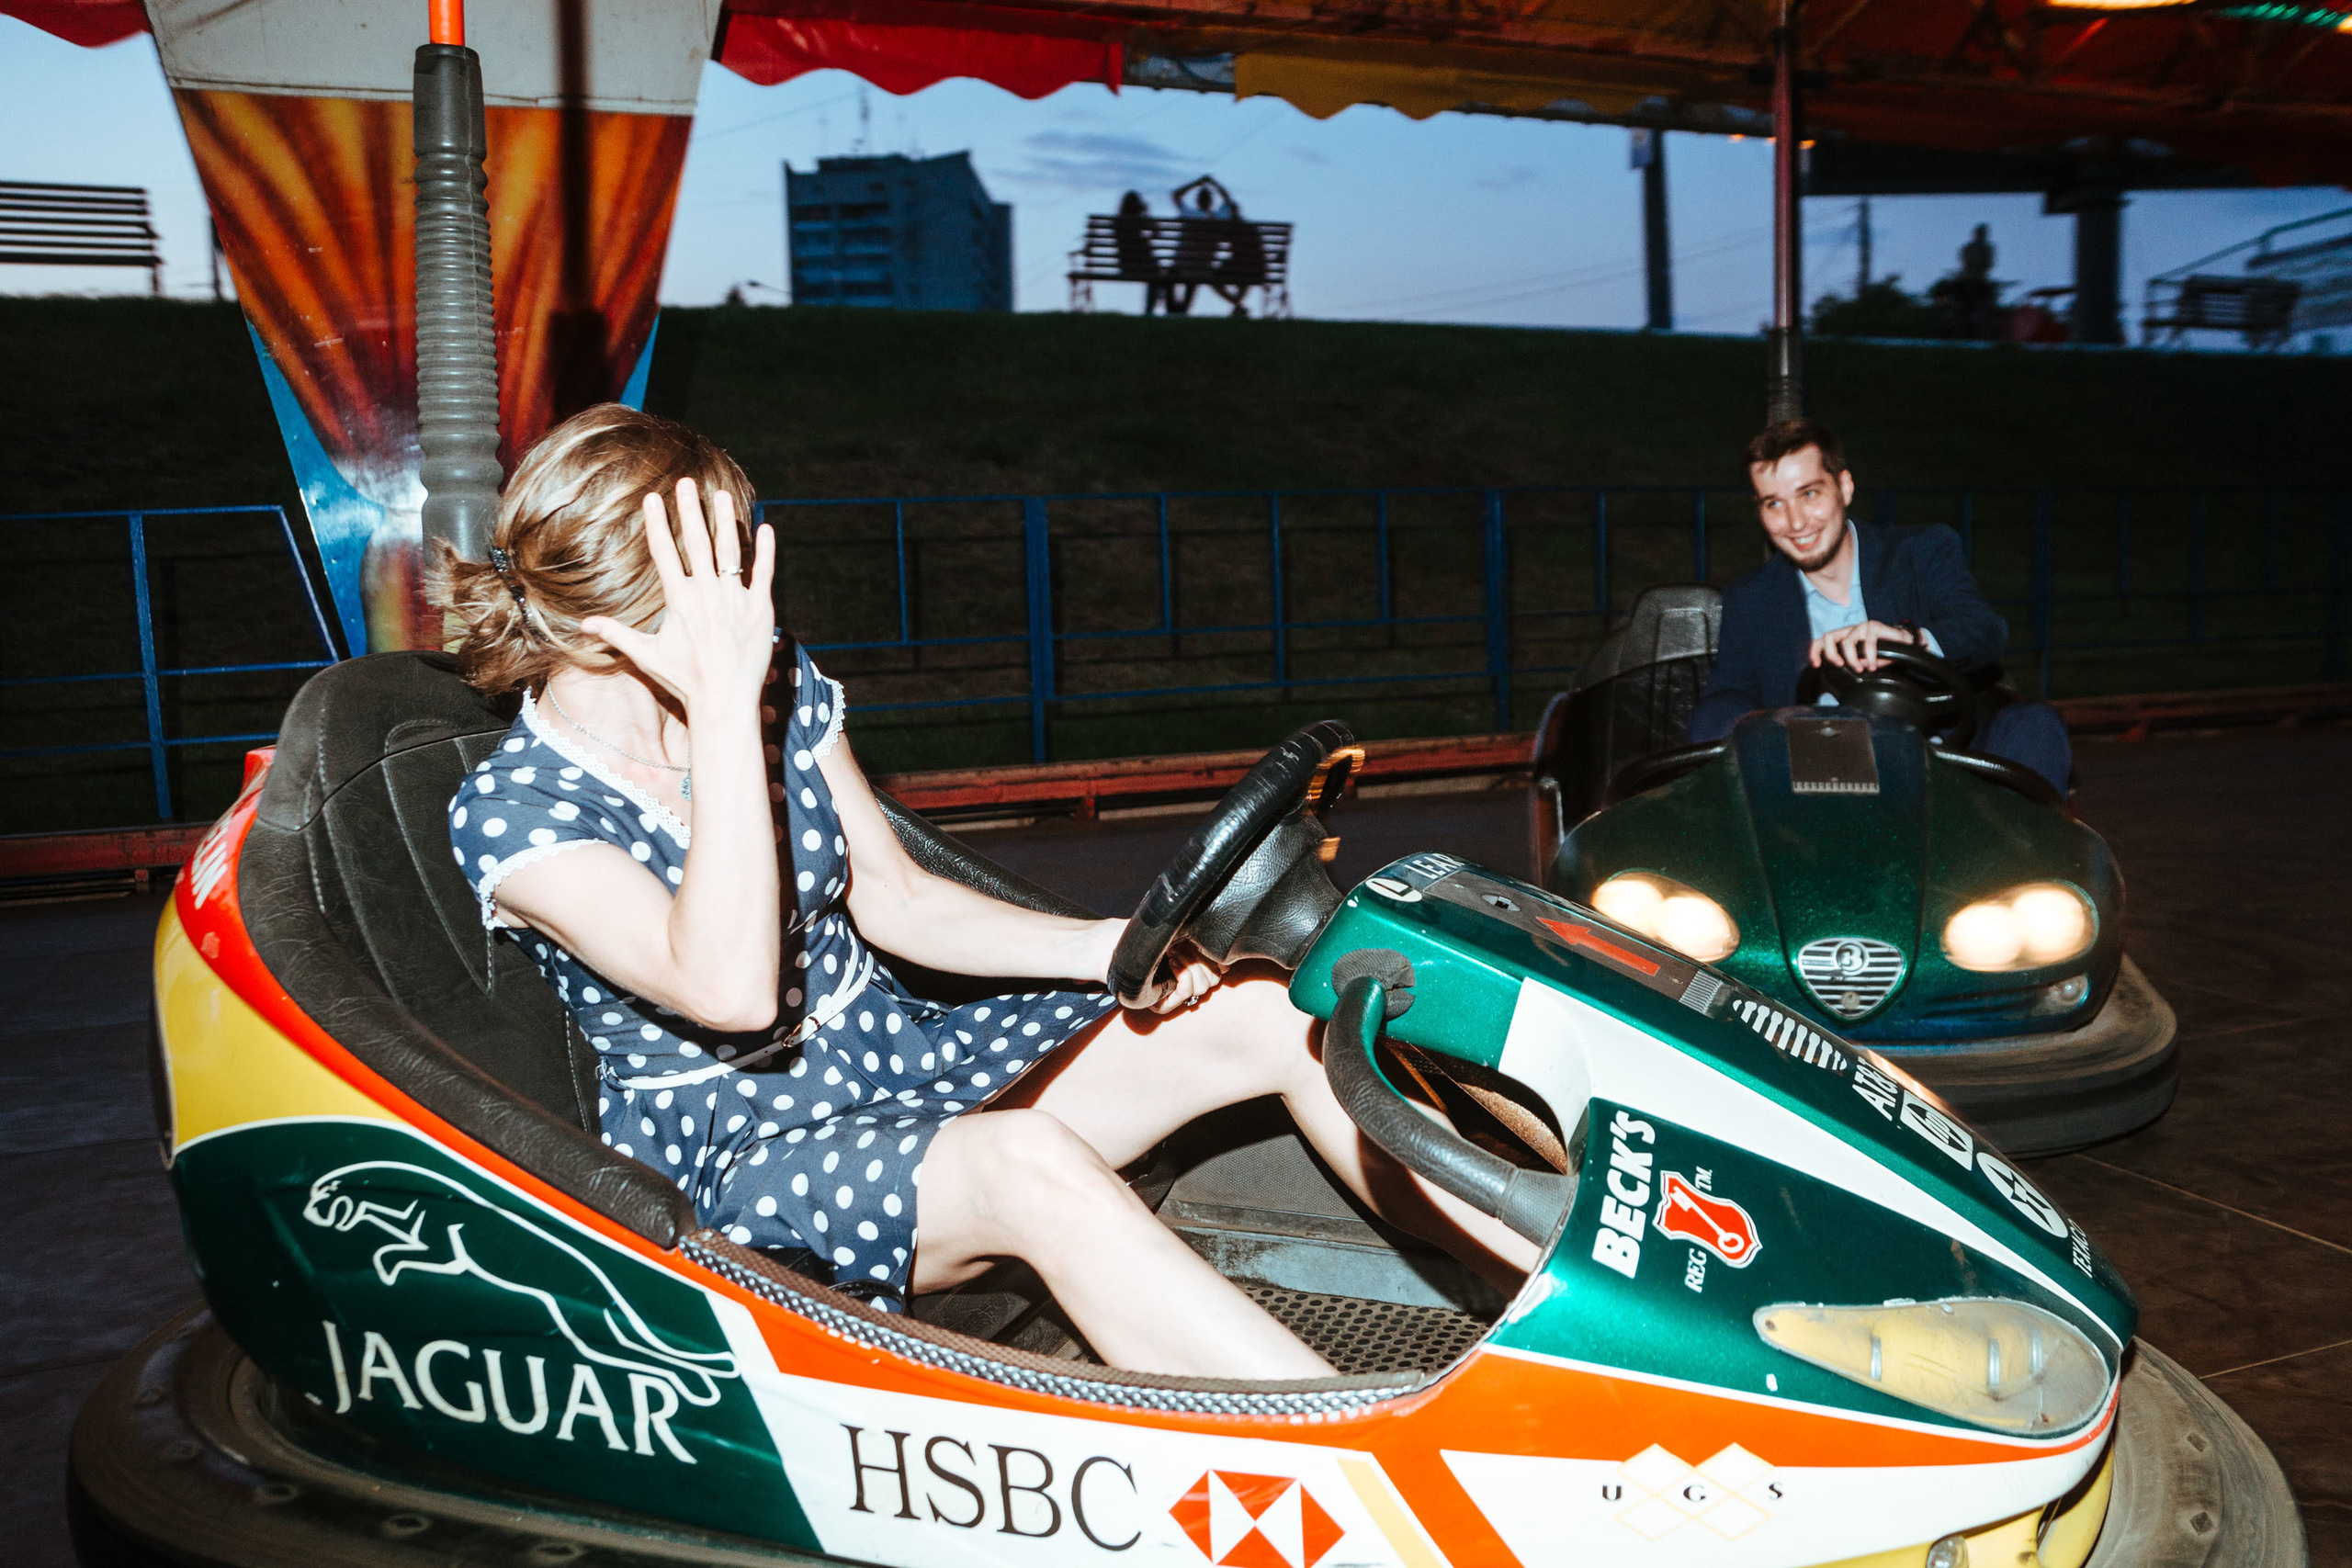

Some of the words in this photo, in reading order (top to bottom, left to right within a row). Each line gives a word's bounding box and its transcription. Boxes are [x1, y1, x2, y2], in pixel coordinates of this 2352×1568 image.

[1405, 852, 1464, 880] LEAR
[1852, 1056, 1898, 1122] AT&T
[1591, 1110, 1656, 1280] BECK'S
[1684, 1247, 1708, 1293] REG
[2067, 1218, 2093, 1279] TEXACO
[305, 1319, 698, 1465] JAGUAR
[840, 1423, 1142, 1552] HSBC
